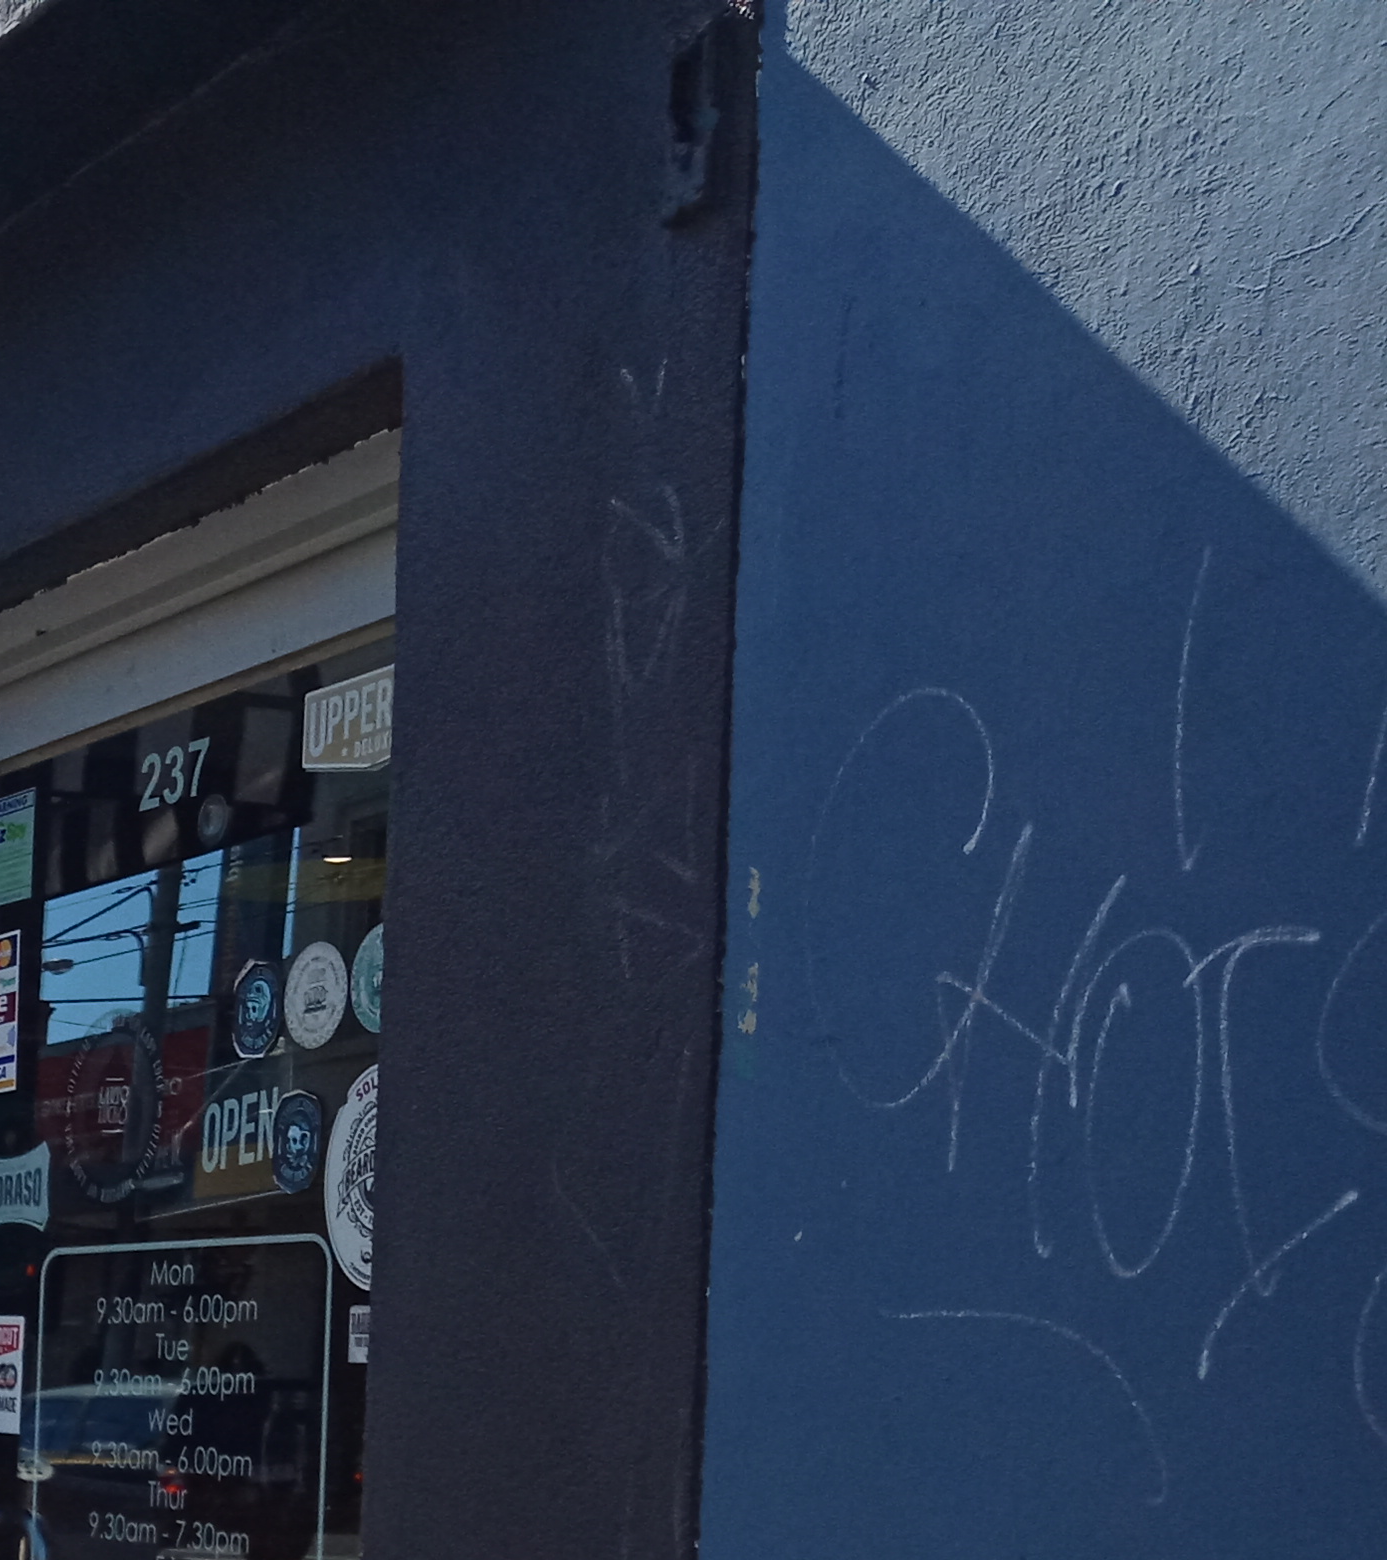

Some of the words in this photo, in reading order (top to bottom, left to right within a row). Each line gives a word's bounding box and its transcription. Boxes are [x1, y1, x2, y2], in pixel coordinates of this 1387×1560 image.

[354, 730, 392, 758] DELUX
[139, 736, 210, 812] 237
[202, 1087, 279, 1173] OPEN
[150, 1260, 195, 1286] Mon
[96, 1296, 165, 1325] 9.30am
[183, 1294, 258, 1329] 6.00pm
[155, 1332, 190, 1361] Tue
[94, 1368, 163, 1396] 9.30am
[180, 1367, 255, 1401] 6.00pm
[148, 1407, 194, 1436] Wed
[91, 1440, 160, 1470] 9.30am
[178, 1446, 253, 1481] 6.00pm
[147, 1480, 189, 1510] Thur
[88, 1510, 157, 1544] 9.30am
[175, 1520, 250, 1559] 7.30pm
